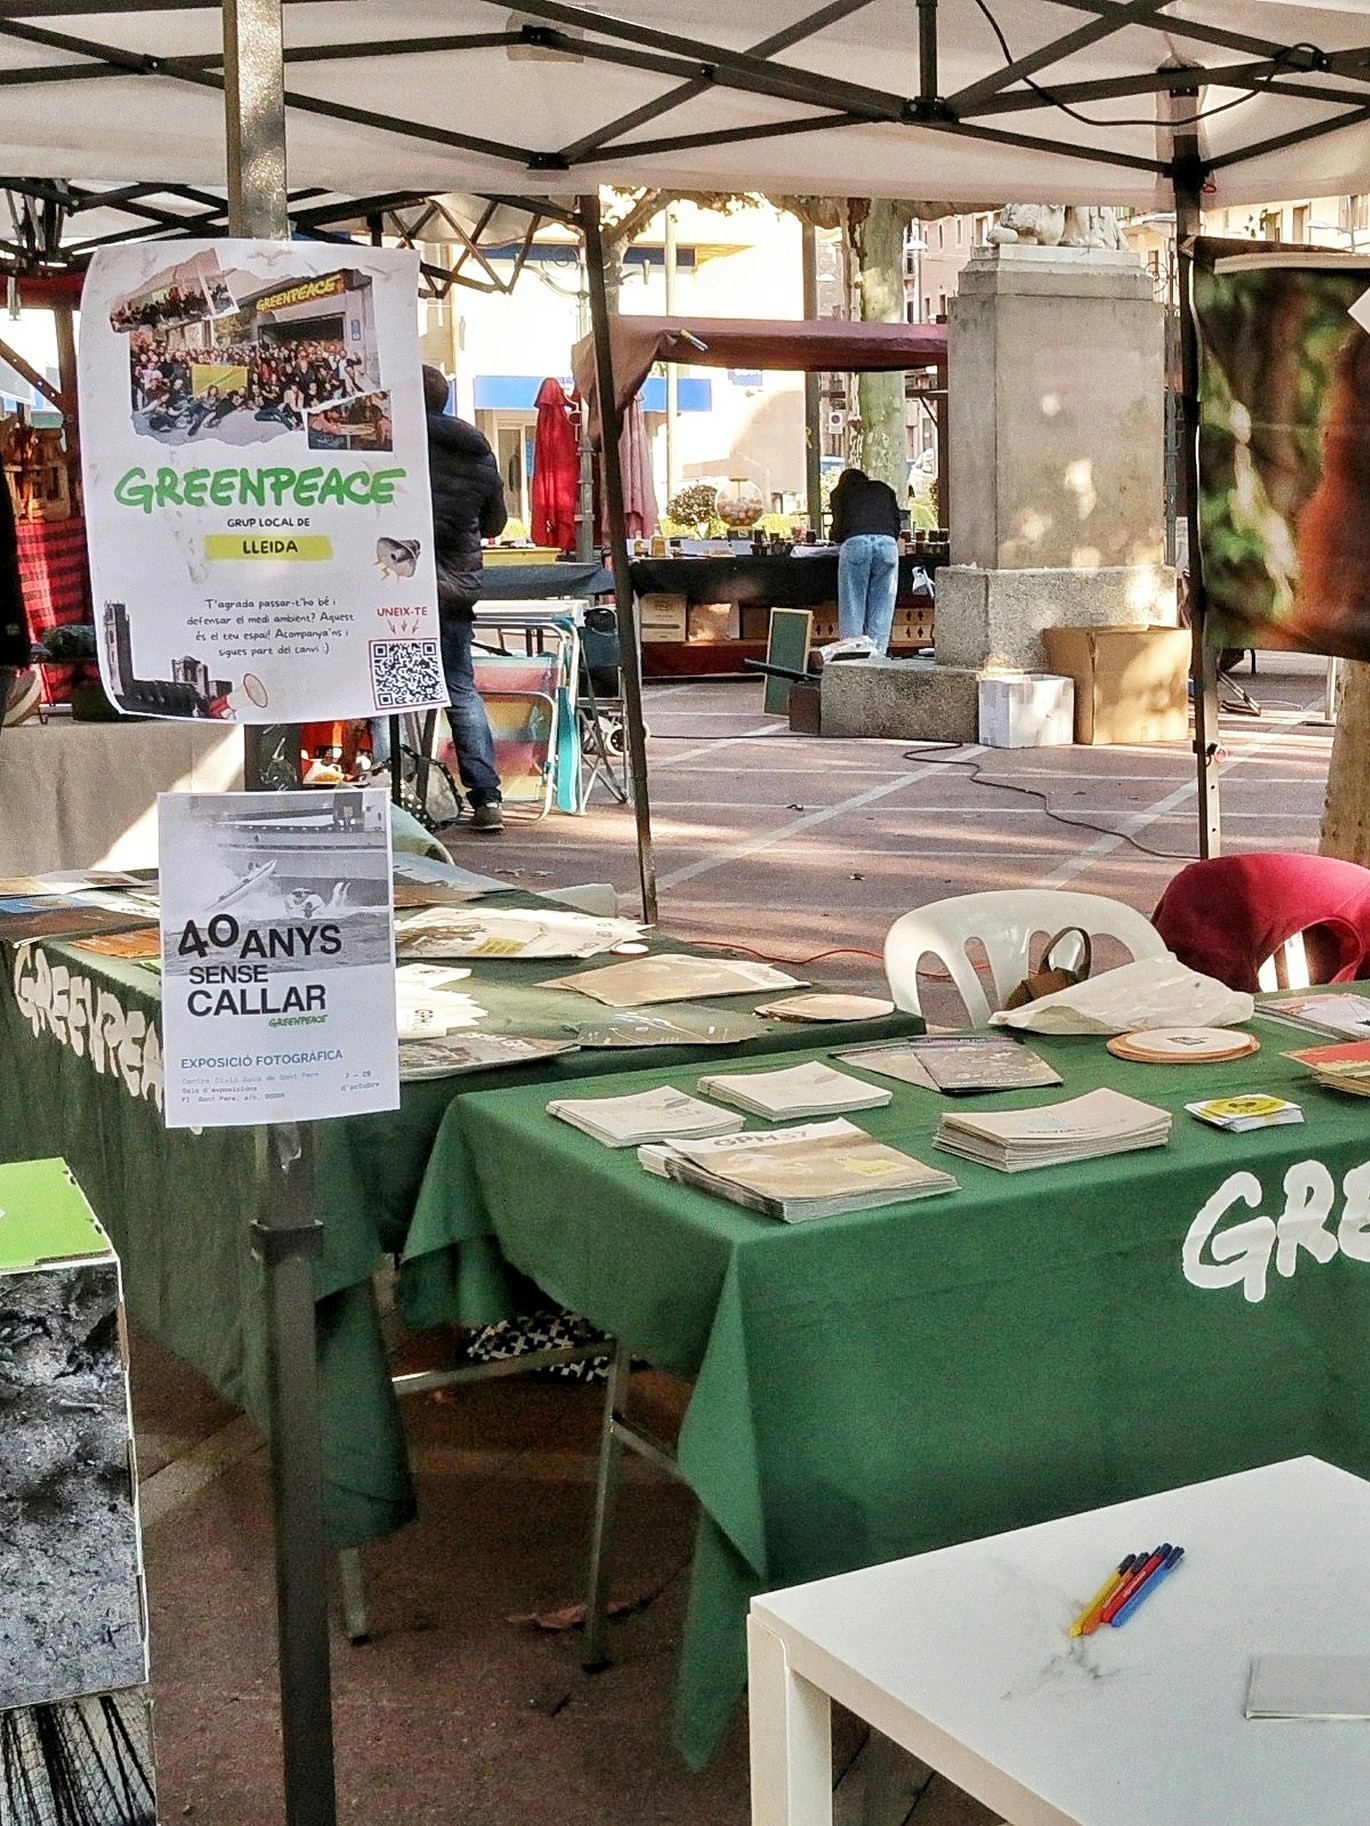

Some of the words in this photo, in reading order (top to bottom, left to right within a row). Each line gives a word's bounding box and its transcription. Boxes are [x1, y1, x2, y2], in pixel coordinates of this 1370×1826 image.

[256, 274, 341, 311] GREENPEACE
[114, 467, 406, 514] GREENPEACE
[227, 518, 256, 527] GRUP
[259, 518, 294, 527] LOCAL
[297, 518, 310, 527] DE
[243, 540, 298, 554] LLEIDA
[205, 598, 254, 611] T'agrada
[258, 598, 314, 610] passar-t'ho
[318, 596, 329, 606] bé
[187, 616, 231, 625] defensar
[236, 616, 244, 624] el
[248, 615, 270, 623] medi
[274, 612, 316, 623] ambient?
[320, 611, 354, 623] Aquest
[376, 606, 428, 617] UNEIX-TE
[195, 631, 206, 640] és
[210, 632, 219, 640] el
[243, 630, 270, 640] espai!
[275, 628, 342, 640] Acompanya'ns
[218, 648, 247, 658] sigues
[251, 648, 273, 656] part
[277, 646, 290, 654] del
[294, 645, 319, 654] canvi
[178, 914, 240, 958] 40
[239, 924, 342, 959] ANYS
[189, 964, 268, 985] SENSE
[187, 984, 326, 1017] CALLAR
[14, 944, 166, 1113] GREENPEA
[268, 1015, 328, 1028] GREENPEACE
[181, 1055, 252, 1069] EXPOSICIÓ
[256, 1049, 343, 1066] FOTOGRÀFICA
